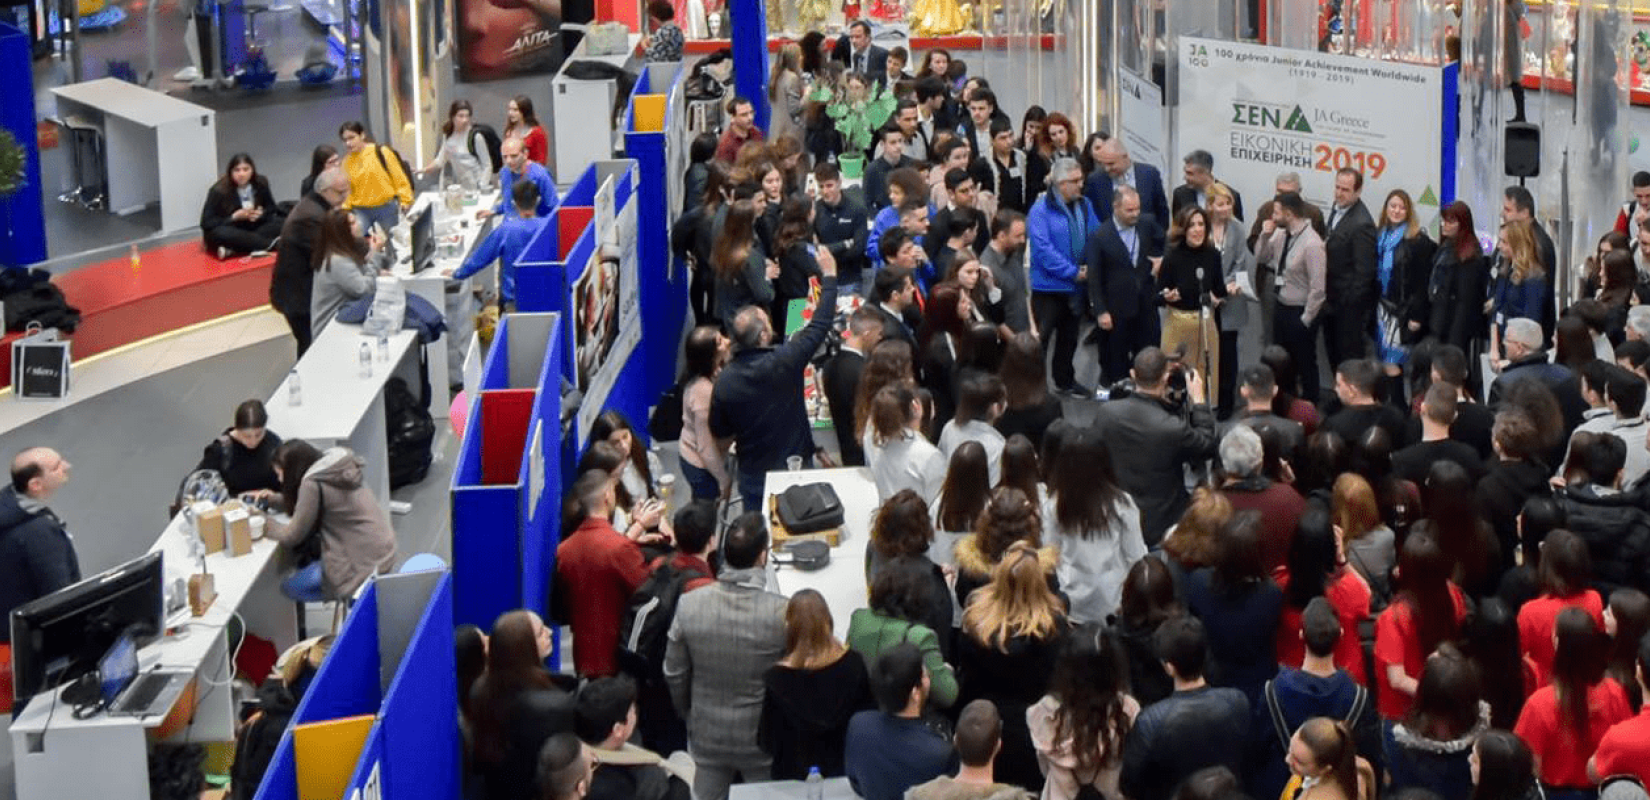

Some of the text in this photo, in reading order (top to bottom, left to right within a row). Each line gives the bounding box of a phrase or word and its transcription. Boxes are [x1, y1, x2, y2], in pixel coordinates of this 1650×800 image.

[1215, 48, 1233, 58] 100
[1272, 56, 1303, 66] Junior
[1305, 60, 1369, 76] Achievement
[1371, 68, 1426, 83] Worldwide
[1232, 103, 1280, 129] ΣΕΝ
[1313, 108, 1370, 129] JA Greece
[1230, 131, 1312, 156] ΕΙΚΟΝΙΚΗ
[1230, 147, 1312, 168] ΕΠΙΧΕΙΡΗΣΗ
[1315, 145, 1386, 179] 2019
